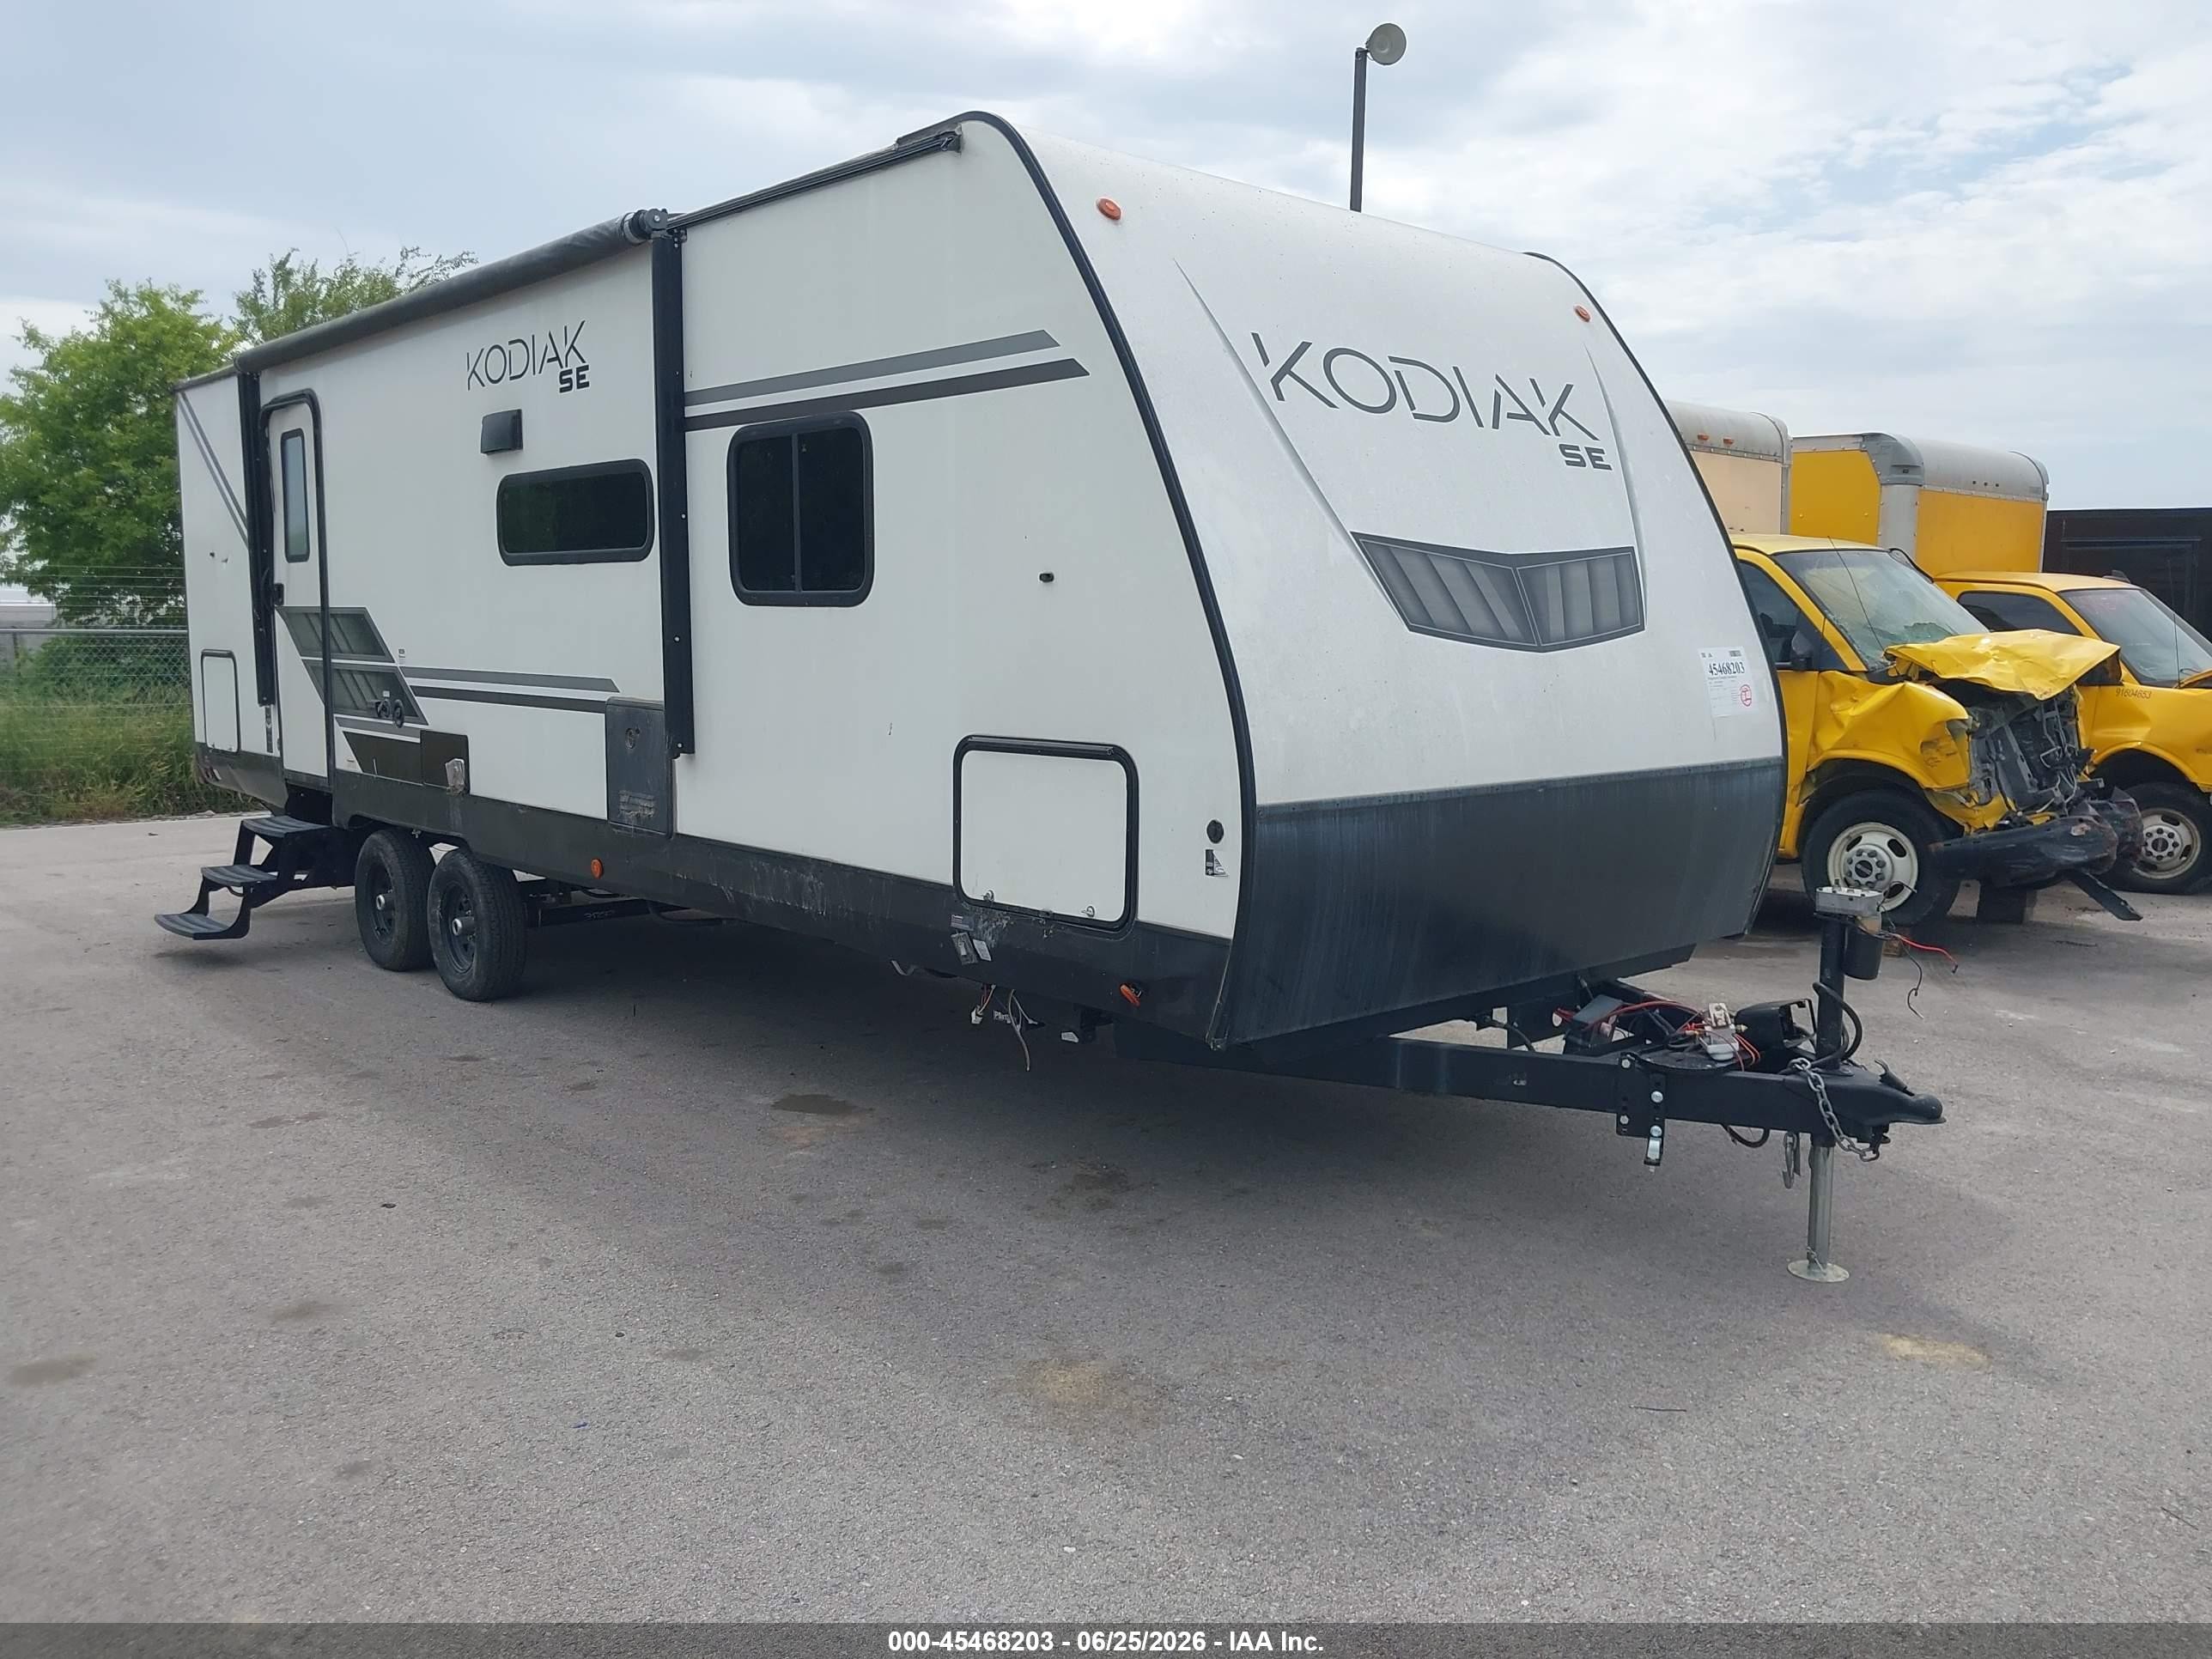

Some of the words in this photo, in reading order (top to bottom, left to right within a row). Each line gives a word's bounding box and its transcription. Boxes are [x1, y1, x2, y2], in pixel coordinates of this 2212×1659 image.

[467, 320, 586, 391] KODIAK
[559, 365, 590, 393] SE
[1250, 331, 1601, 441] KODIAK
[1559, 443, 1613, 471] SE
[1709, 661, 1745, 676] 45468203
